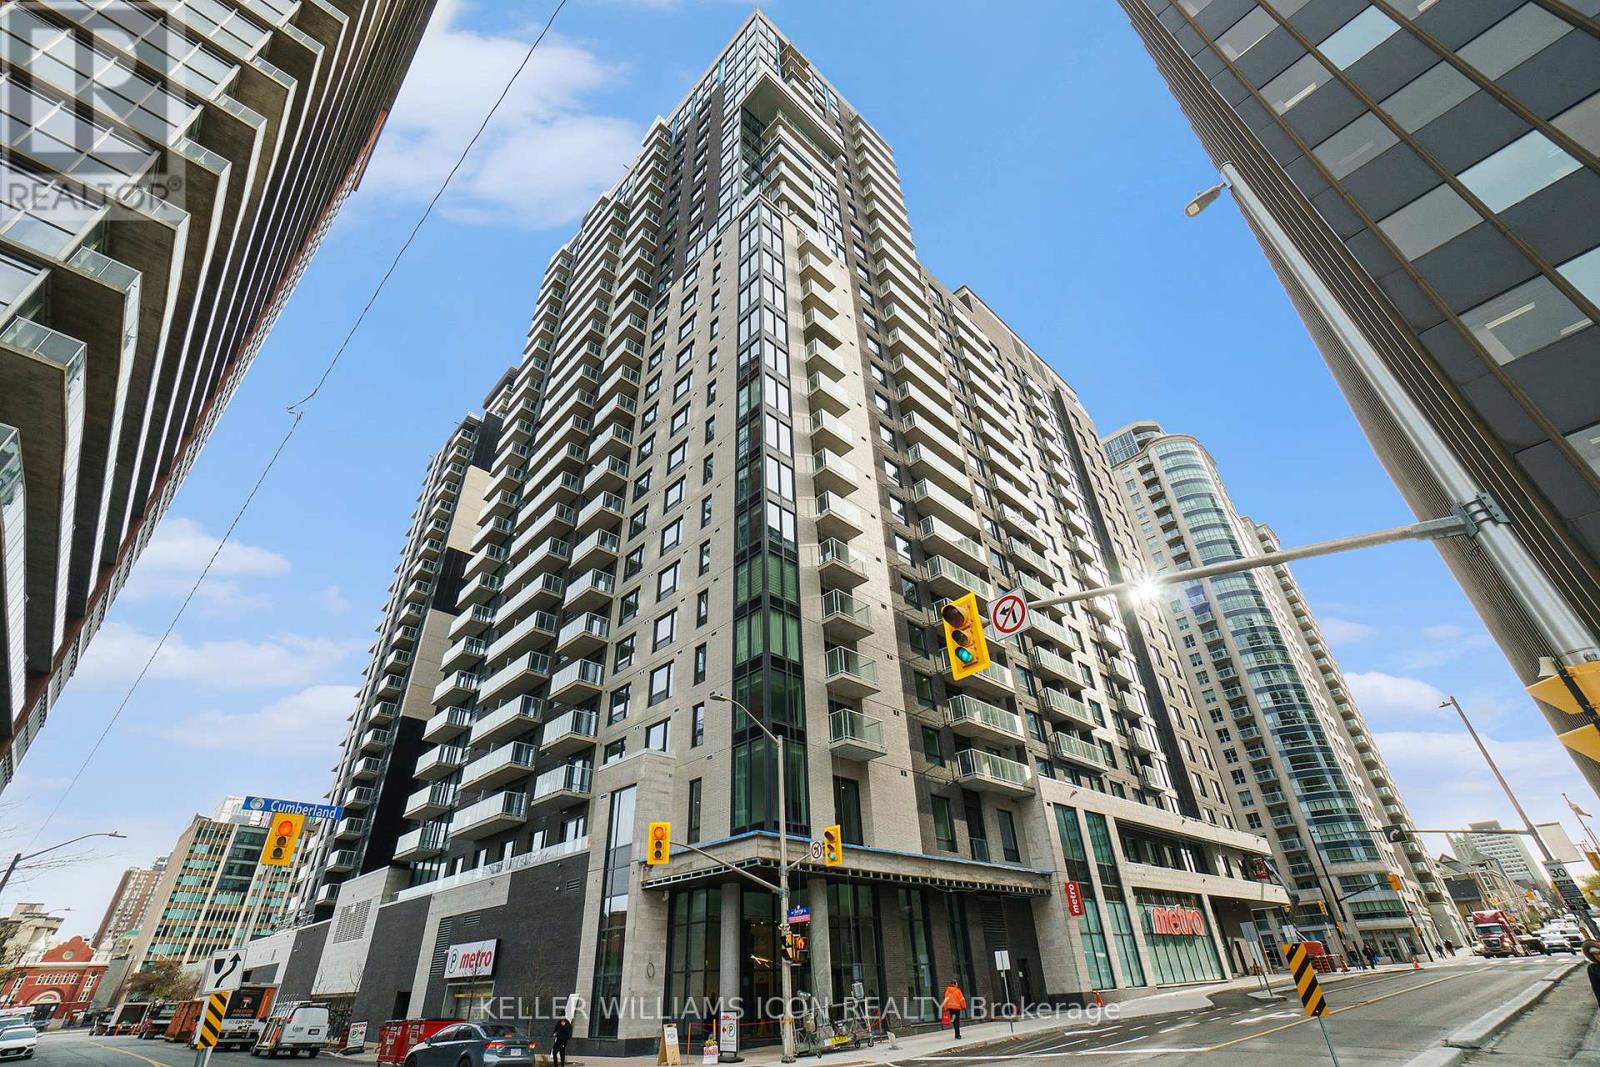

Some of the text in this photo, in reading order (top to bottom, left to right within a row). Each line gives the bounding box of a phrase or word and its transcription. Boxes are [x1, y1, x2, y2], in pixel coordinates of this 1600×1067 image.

[270, 801, 338, 818] Cumberland
[1549, 868, 1567, 879] 30
[1068, 884, 1080, 913] metro
[1152, 904, 1206, 936] metro
[459, 950, 493, 969] metro
